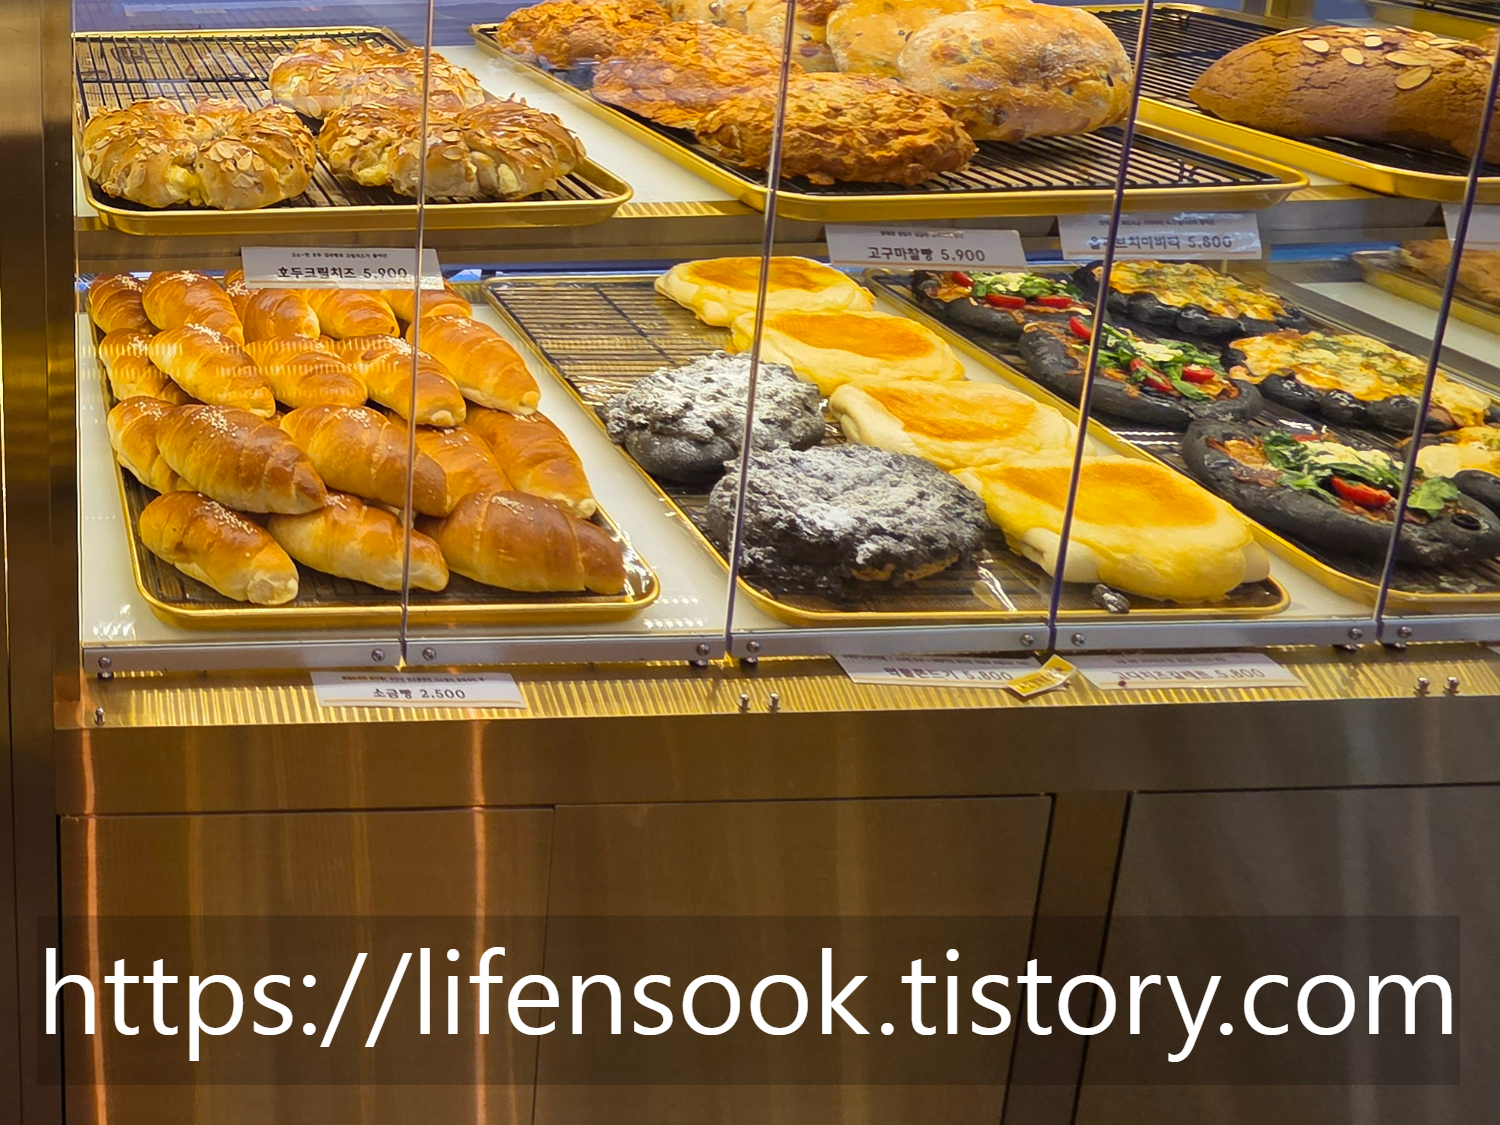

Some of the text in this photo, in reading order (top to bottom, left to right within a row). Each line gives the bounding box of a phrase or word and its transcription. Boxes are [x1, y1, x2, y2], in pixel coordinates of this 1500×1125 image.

[1090, 235, 1232, 250] 올브치아바타 5,800
[868, 247, 986, 262] 고구마찰빵 5,900
[277, 267, 408, 279] 호두크림치즈 5,900
[961, 670, 1014, 681] 5,800
[1215, 668, 1265, 679] 5,800
[373, 688, 466, 699] 소금빵 2,500
